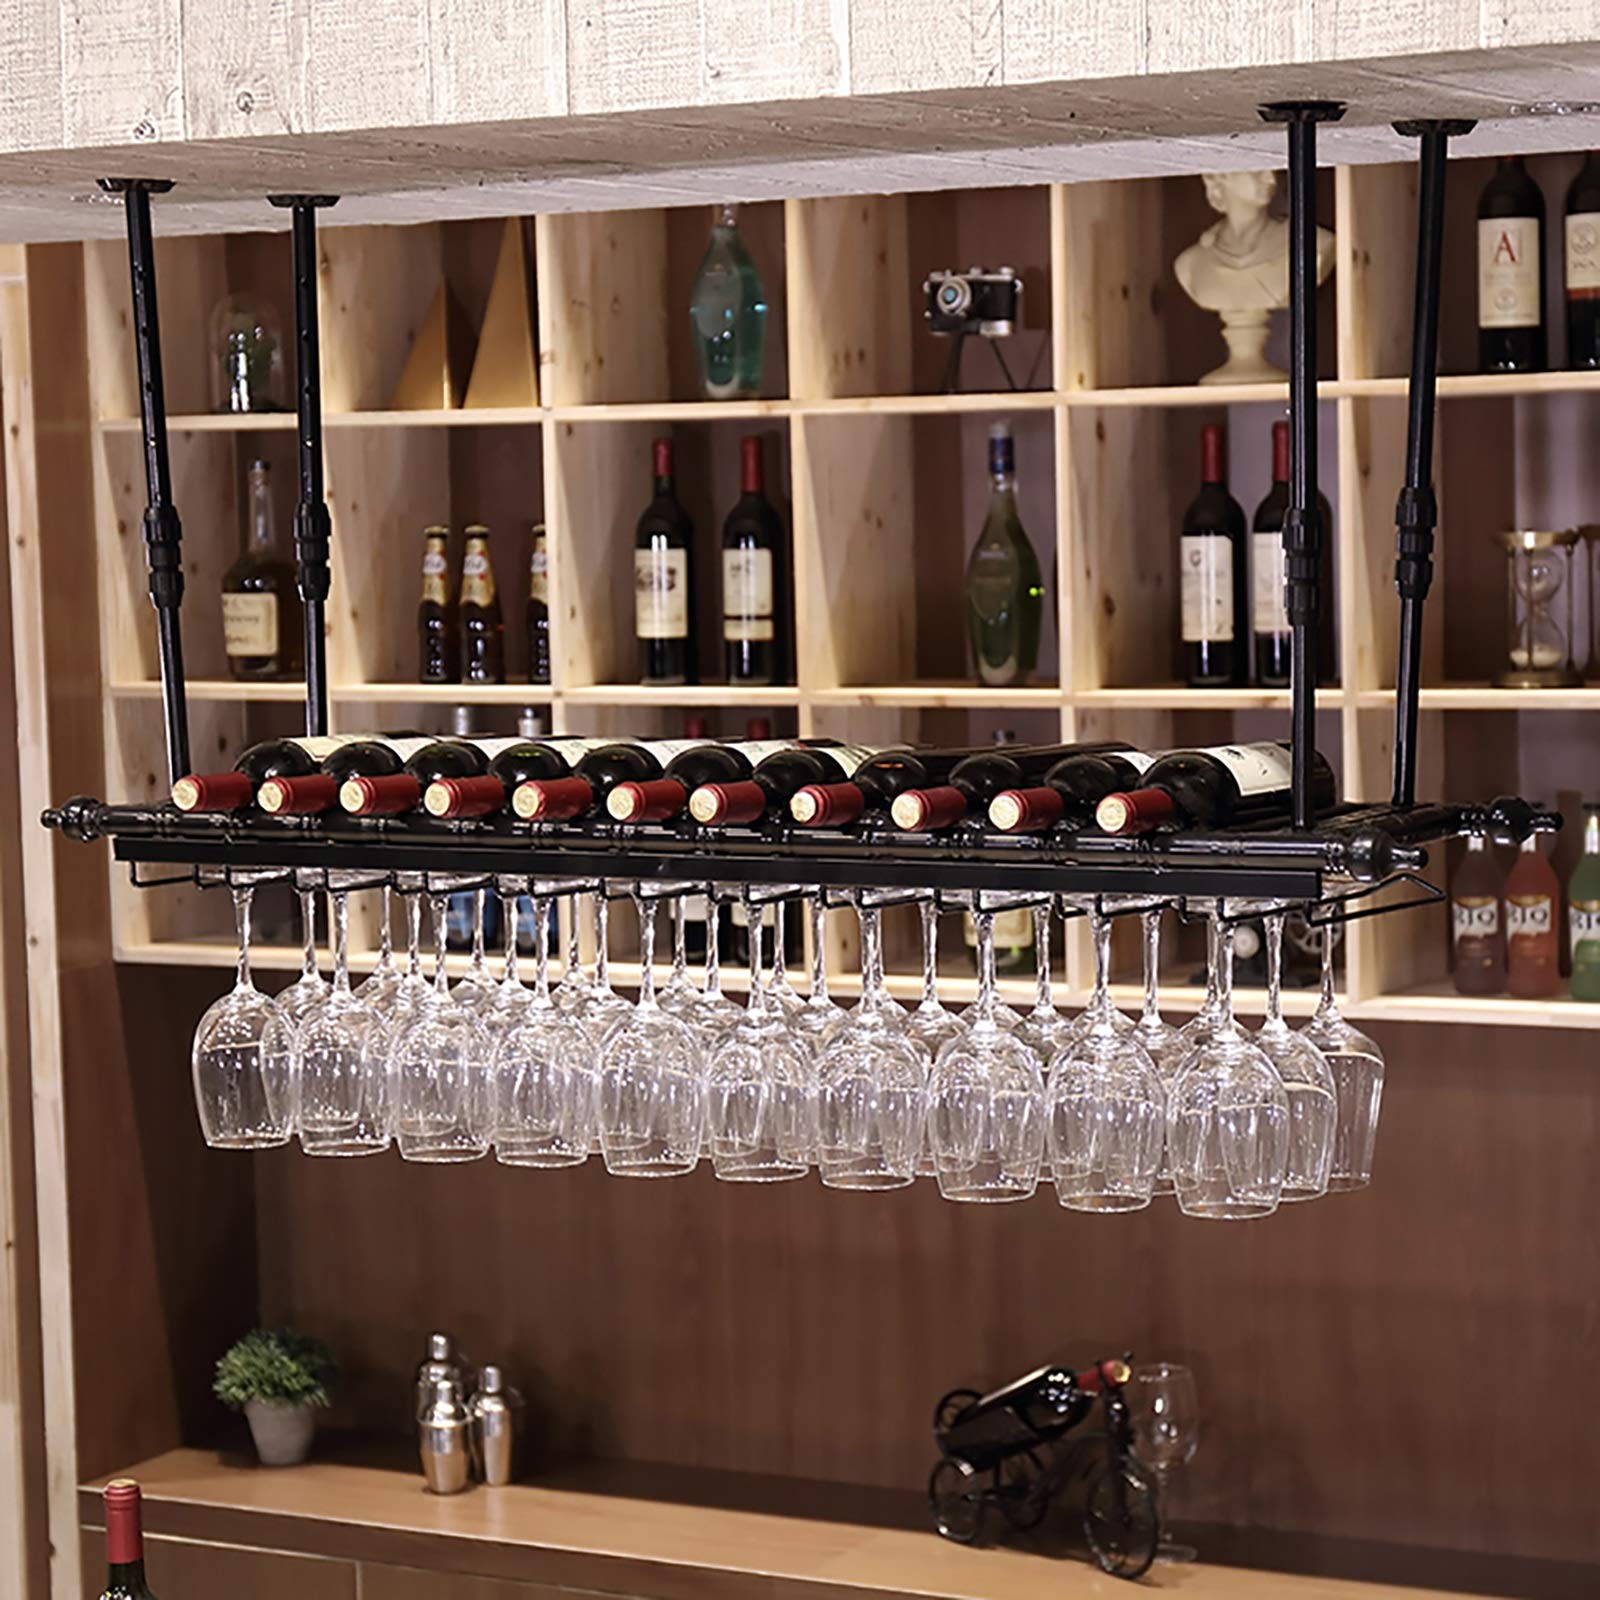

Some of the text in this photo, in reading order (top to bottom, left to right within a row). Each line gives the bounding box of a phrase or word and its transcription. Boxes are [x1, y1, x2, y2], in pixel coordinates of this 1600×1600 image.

[1492, 230, 1518, 266] A
[1455, 908, 1495, 925] RIO
[1509, 907, 1548, 924] RIO
